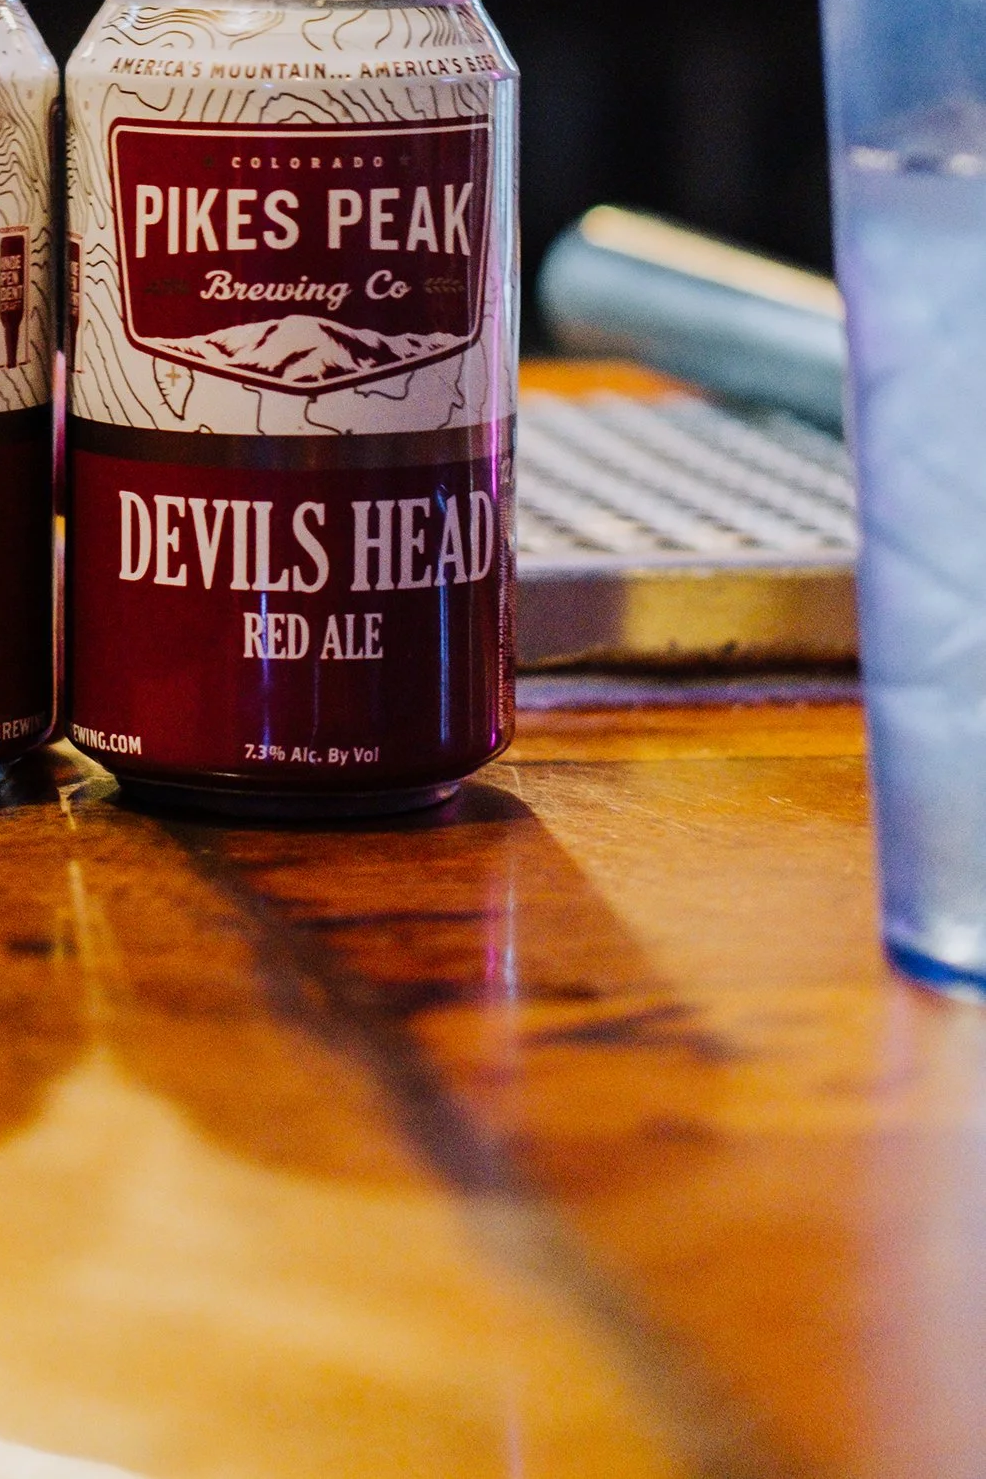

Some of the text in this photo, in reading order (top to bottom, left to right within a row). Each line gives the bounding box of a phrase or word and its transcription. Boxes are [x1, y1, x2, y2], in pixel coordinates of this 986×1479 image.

[110, 53, 500, 79] AMERICA'S MOUNTAIN... AMERICA'S BEER
[231, 156, 385, 170] COLORADO
[135, 182, 474, 259] PIKES PEAK
[199, 269, 412, 311] Brewing Co
[118, 490, 330, 593] DEVILS
[349, 490, 495, 592] HEAD
[243, 612, 383, 660] RED ALE
[71, 723, 143, 755] EWING.COM
[244, 743, 379, 766] 7.3% Alc. By Vol
